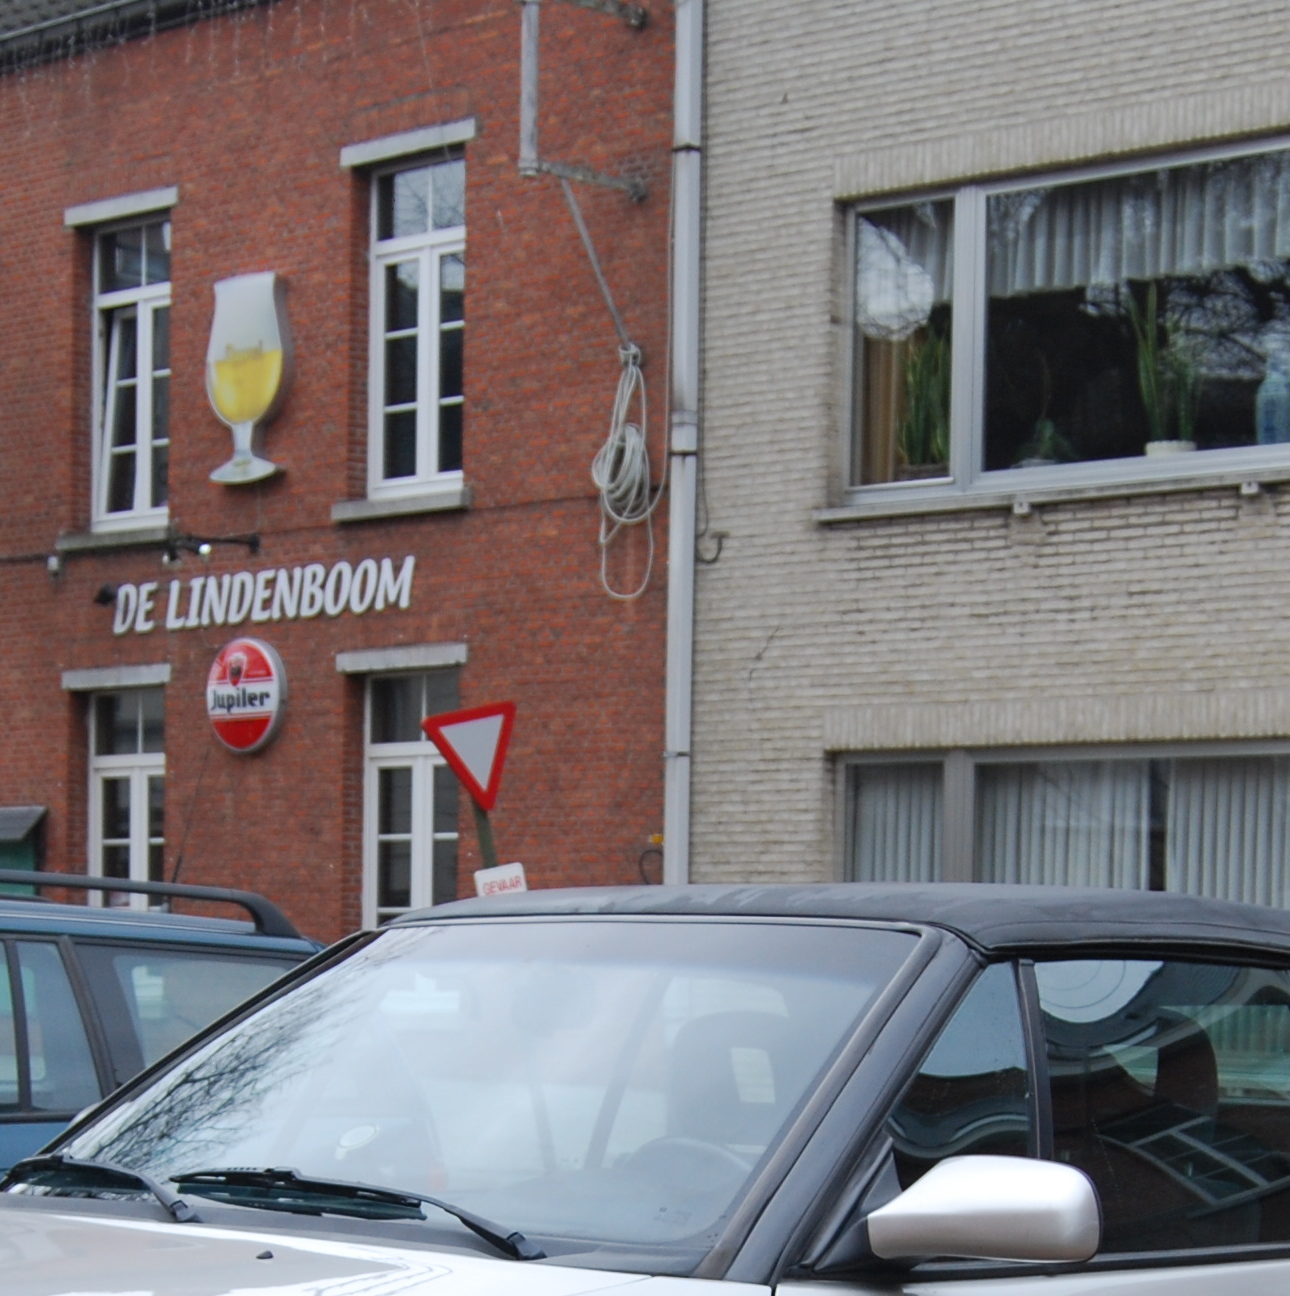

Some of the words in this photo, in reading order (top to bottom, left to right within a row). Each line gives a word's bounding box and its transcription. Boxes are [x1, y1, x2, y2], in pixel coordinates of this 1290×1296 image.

[113, 582, 158, 635] DE
[165, 555, 416, 630] LINDENBOOM
[211, 687, 271, 713] Jupiler
[482, 875, 522, 895] GEVAAR
